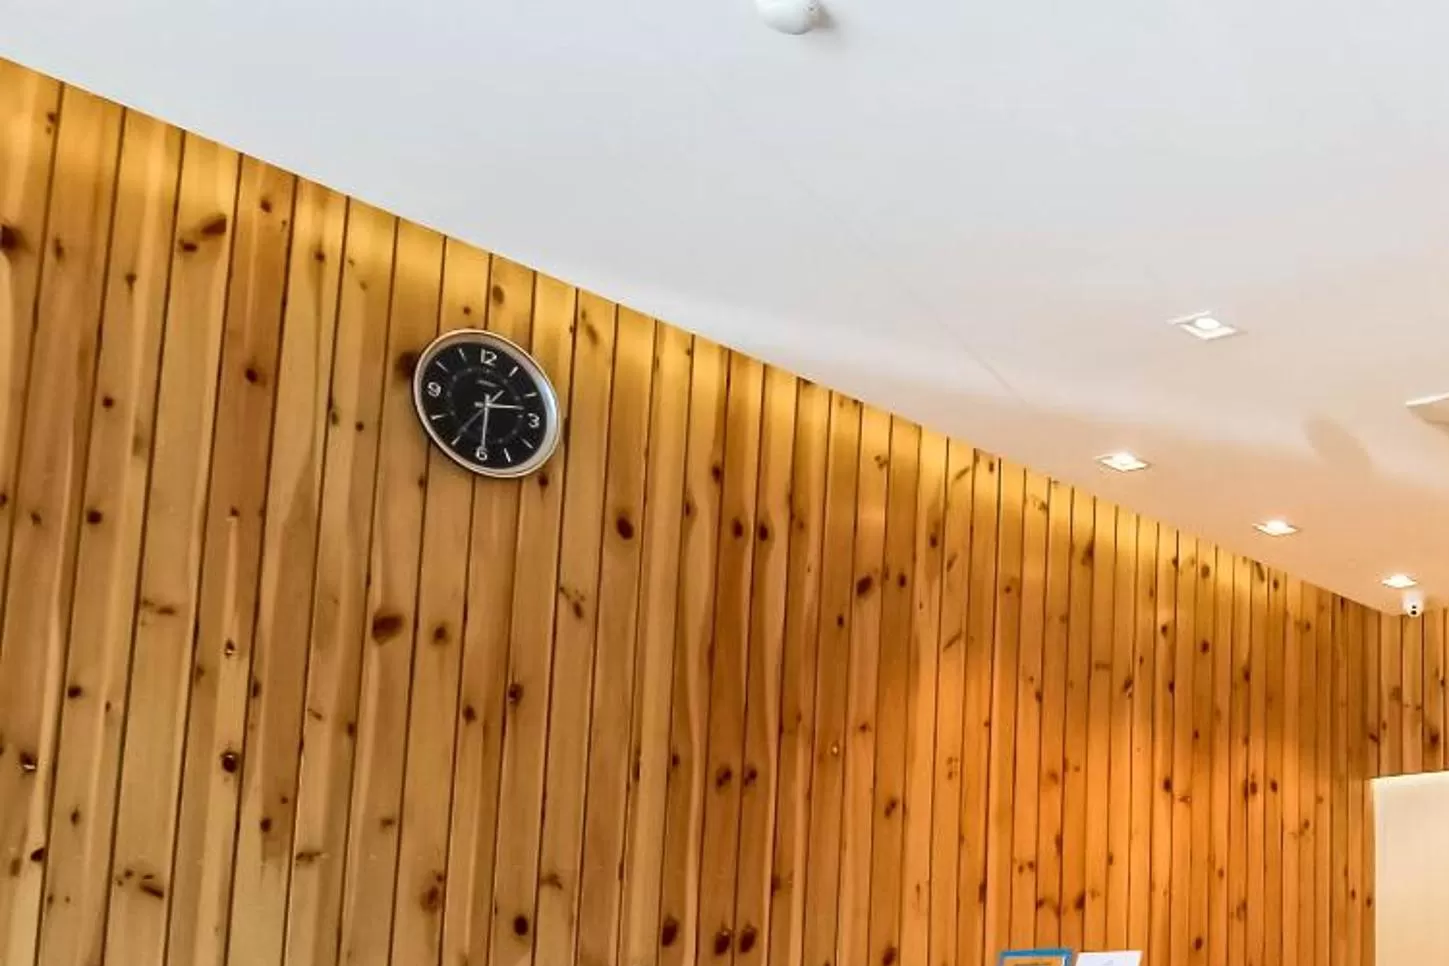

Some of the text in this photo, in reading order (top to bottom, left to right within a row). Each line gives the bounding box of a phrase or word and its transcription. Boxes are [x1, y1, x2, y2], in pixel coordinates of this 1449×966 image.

[480, 348, 498, 367] 12
[427, 381, 442, 398] 9
[527, 412, 541, 429] 3
[475, 446, 489, 461] 6
